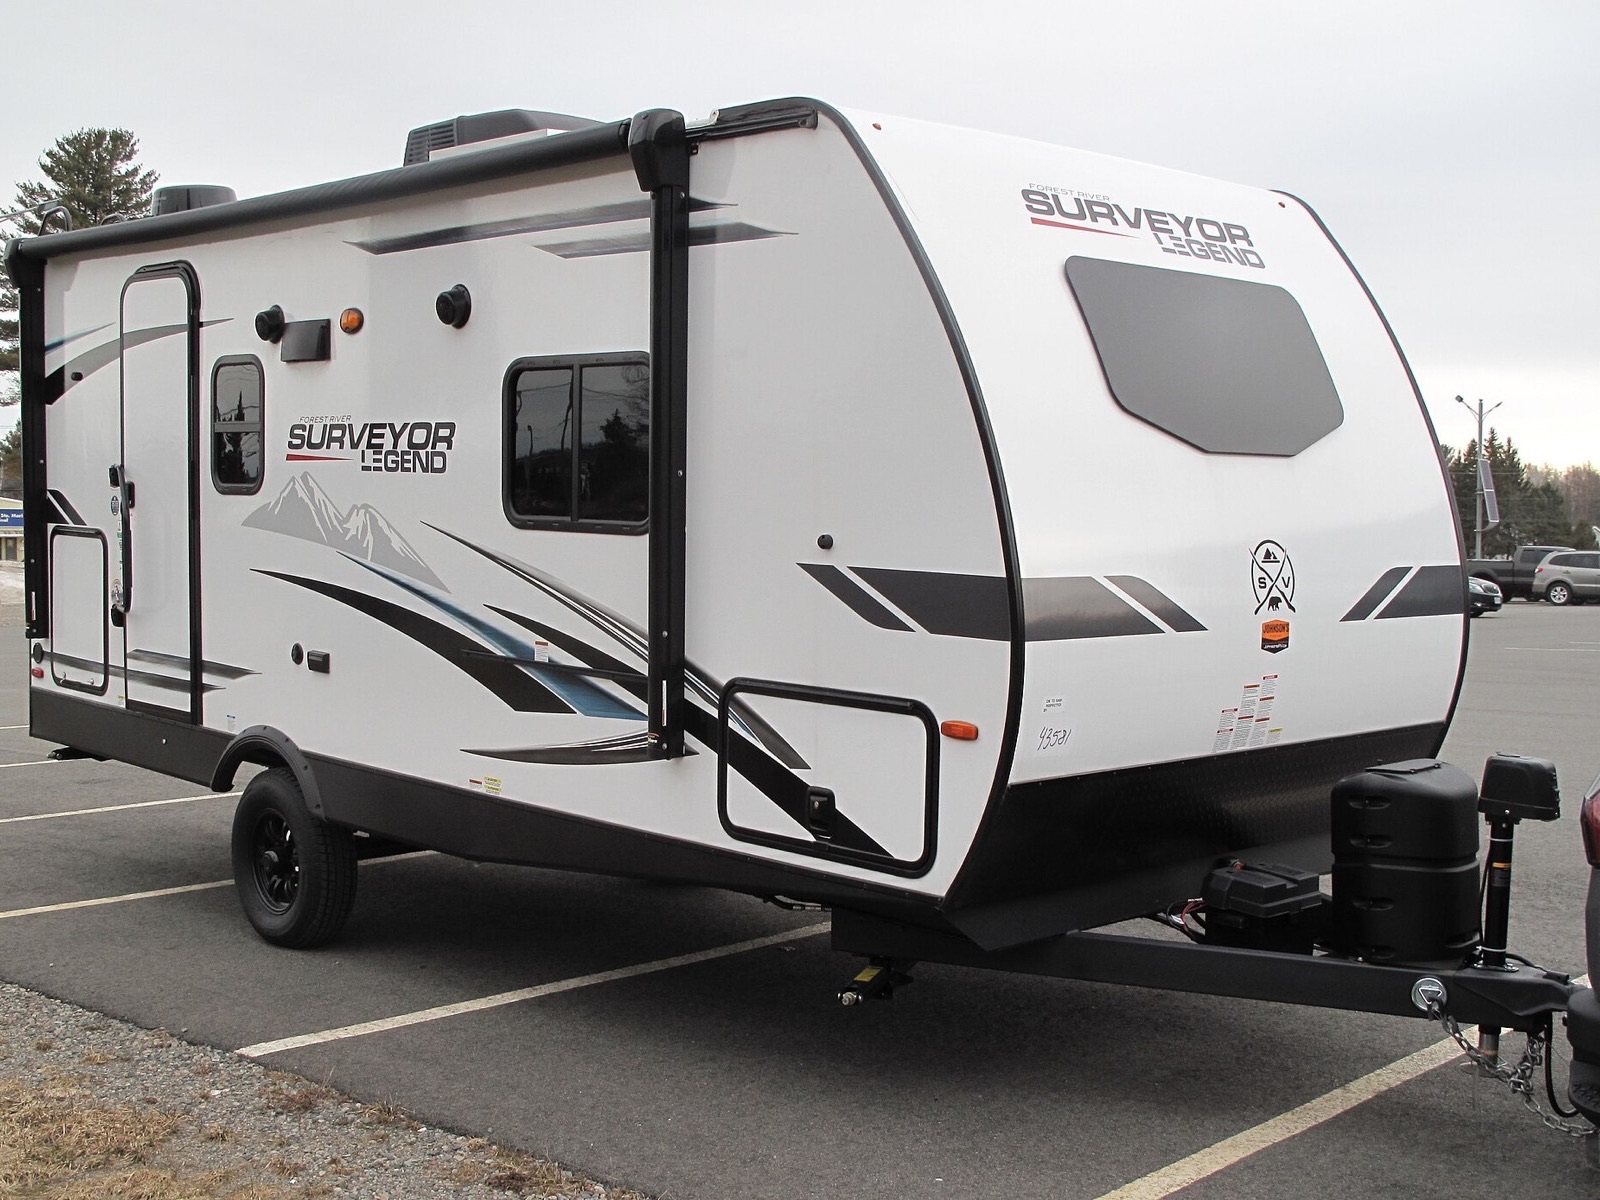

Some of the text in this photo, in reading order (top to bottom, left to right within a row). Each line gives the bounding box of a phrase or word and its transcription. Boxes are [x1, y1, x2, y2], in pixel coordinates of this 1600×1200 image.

[1029, 183, 1110, 201] FOREST RIVER
[1021, 188, 1254, 247] SURVEYOR
[1152, 232, 1266, 269] LEGEND
[300, 415, 328, 423] FOREST
[287, 421, 456, 450] SURVEYOR
[361, 450, 447, 473] LEGEND
[1037, 726, 1072, 751] 43581
